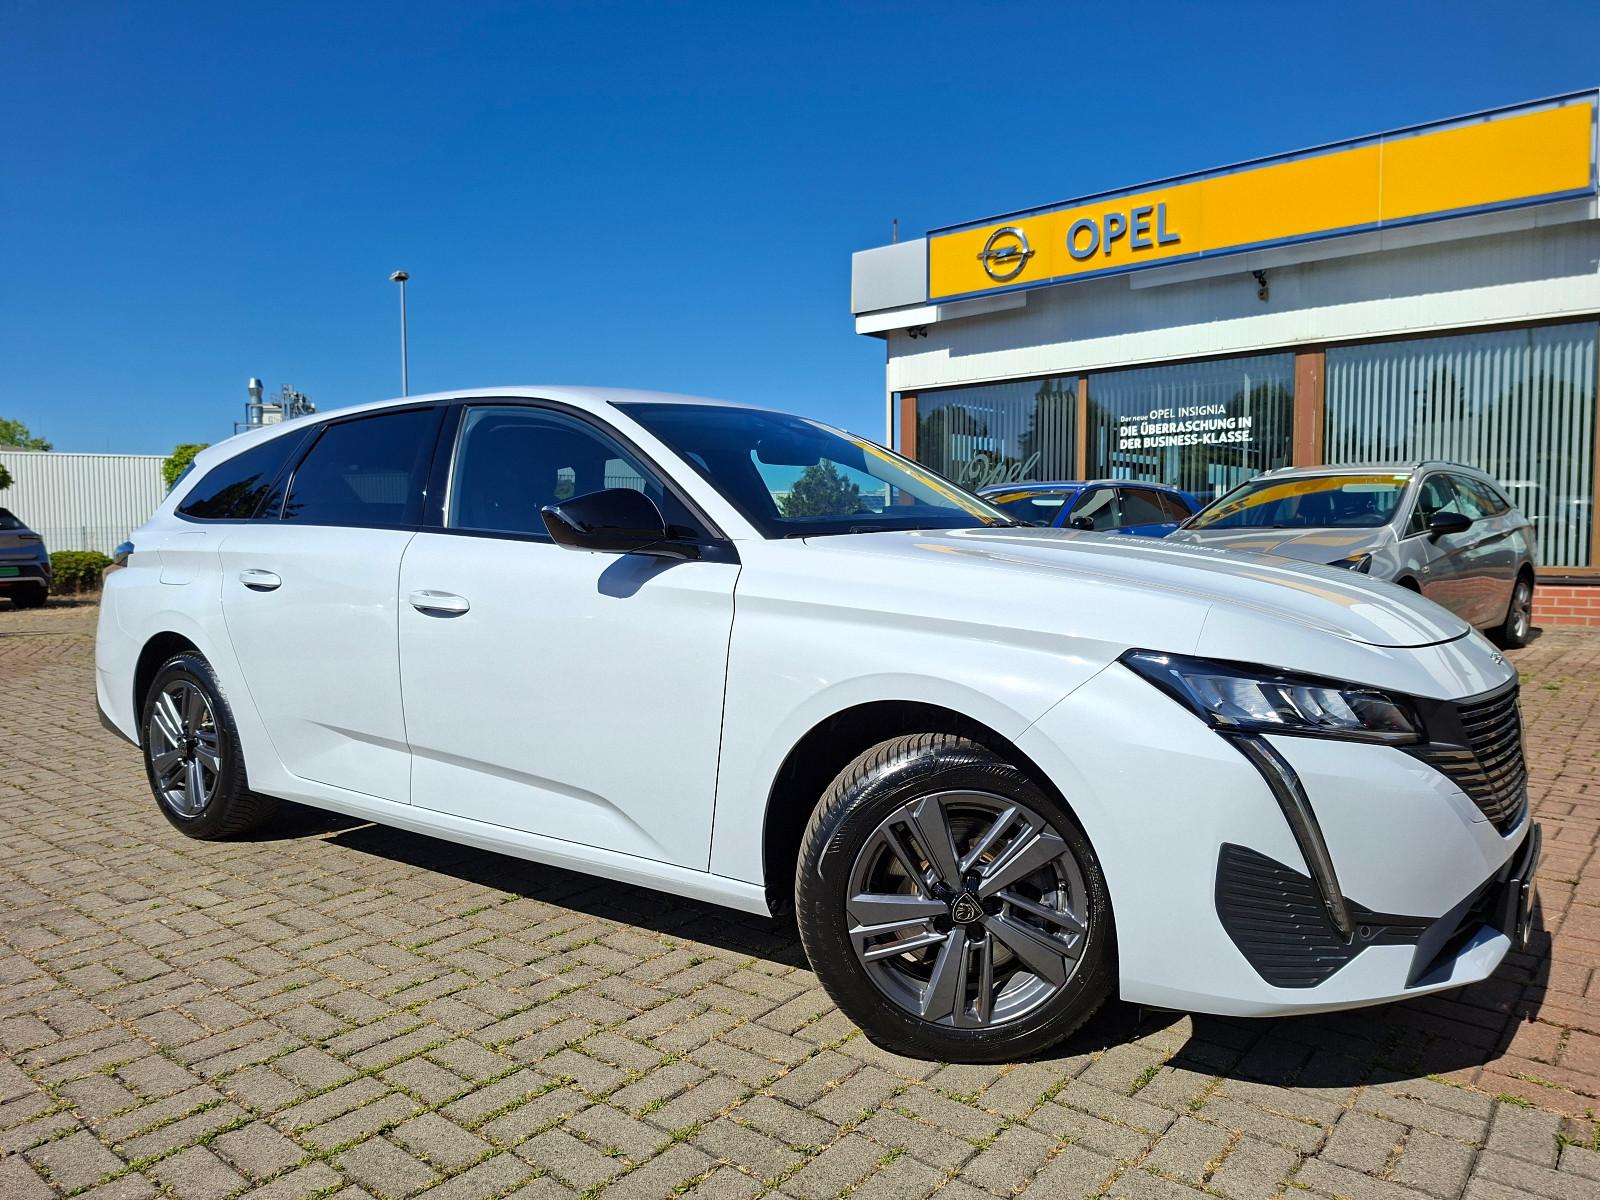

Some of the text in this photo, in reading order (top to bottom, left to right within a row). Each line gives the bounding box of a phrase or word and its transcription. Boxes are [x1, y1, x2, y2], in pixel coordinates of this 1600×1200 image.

[1066, 202, 1180, 260] OPEL
[1120, 415, 1131, 423] Der
[1149, 408, 1176, 420] OPEL
[1178, 404, 1226, 418] INSIGNIA
[1120, 416, 1252, 437] DIE ÜBERRASCHUNG IN
[1120, 430, 1253, 450] DER BUSINESS-KLASSE.
[958, 449, 1040, 492] Opel
